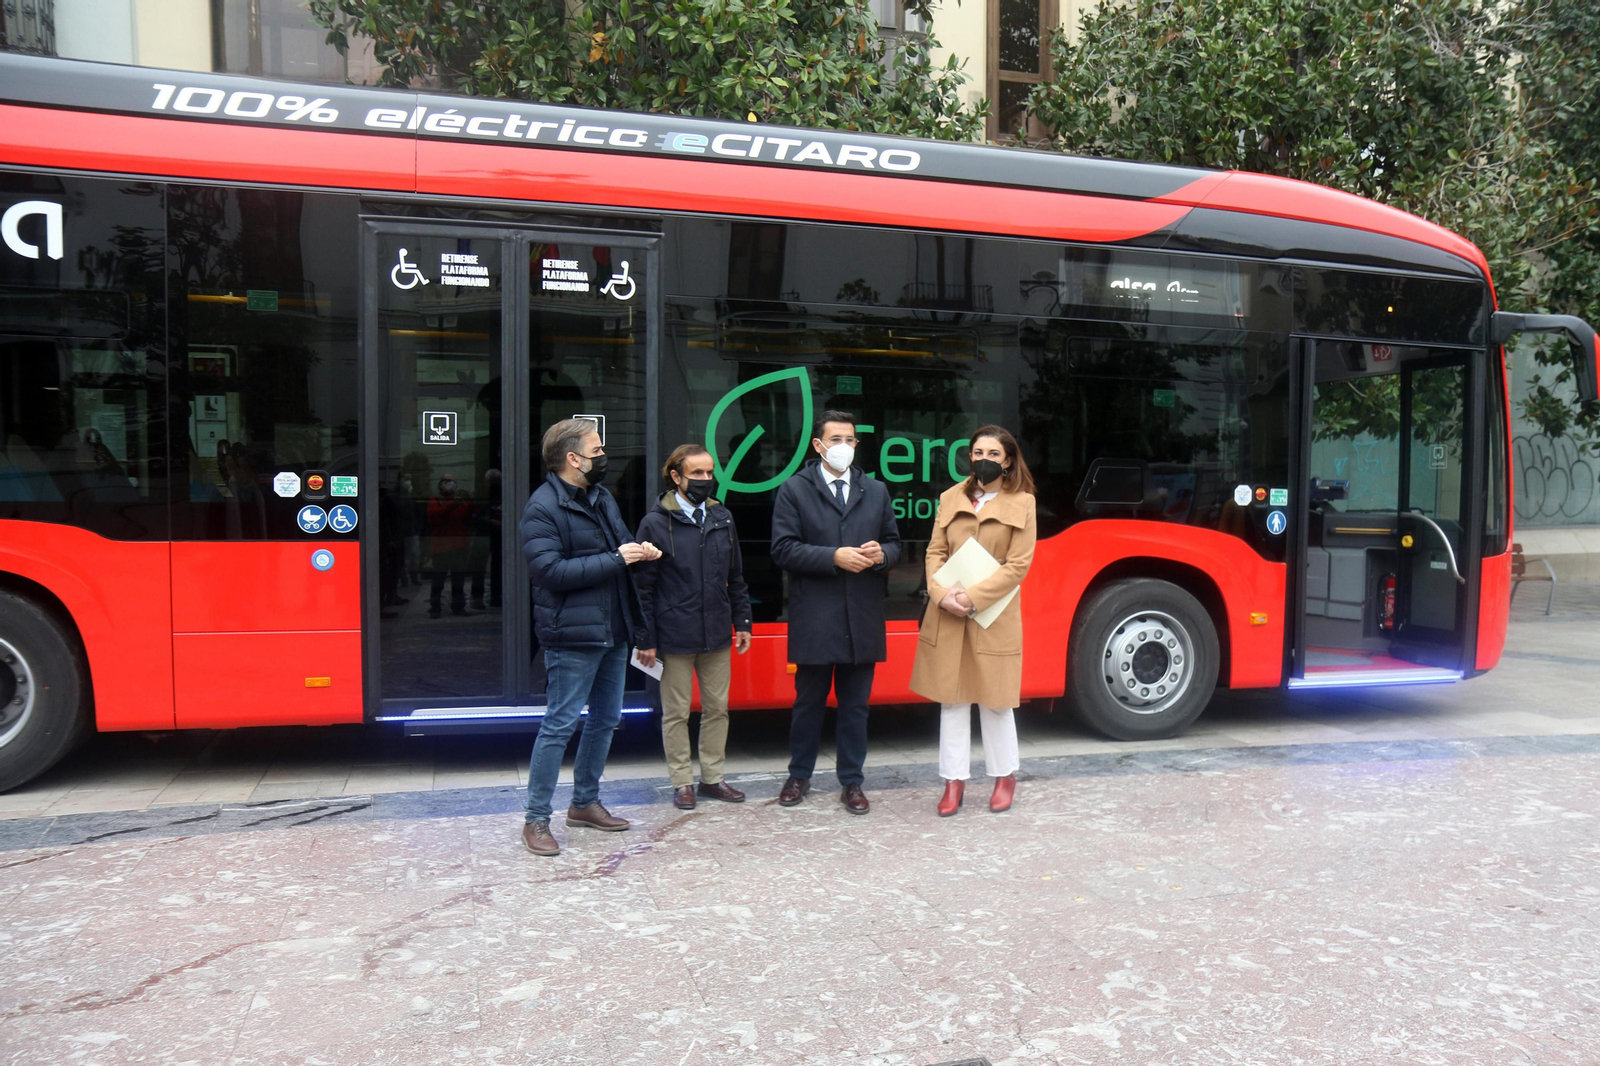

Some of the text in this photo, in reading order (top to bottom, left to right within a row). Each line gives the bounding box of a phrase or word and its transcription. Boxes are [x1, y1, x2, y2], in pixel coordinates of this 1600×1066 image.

[152, 83, 339, 123] 100%
[364, 106, 649, 148] eléctrico
[441, 253, 479, 265] RETIRENSE
[542, 258, 579, 270] RETIRENSE
[441, 264, 489, 277] PLATAFORMA
[542, 269, 589, 281] PLATAFORMA
[441, 275, 490, 287] FUNCIONANDO
[542, 280, 590, 292] FUNCIONANDO
